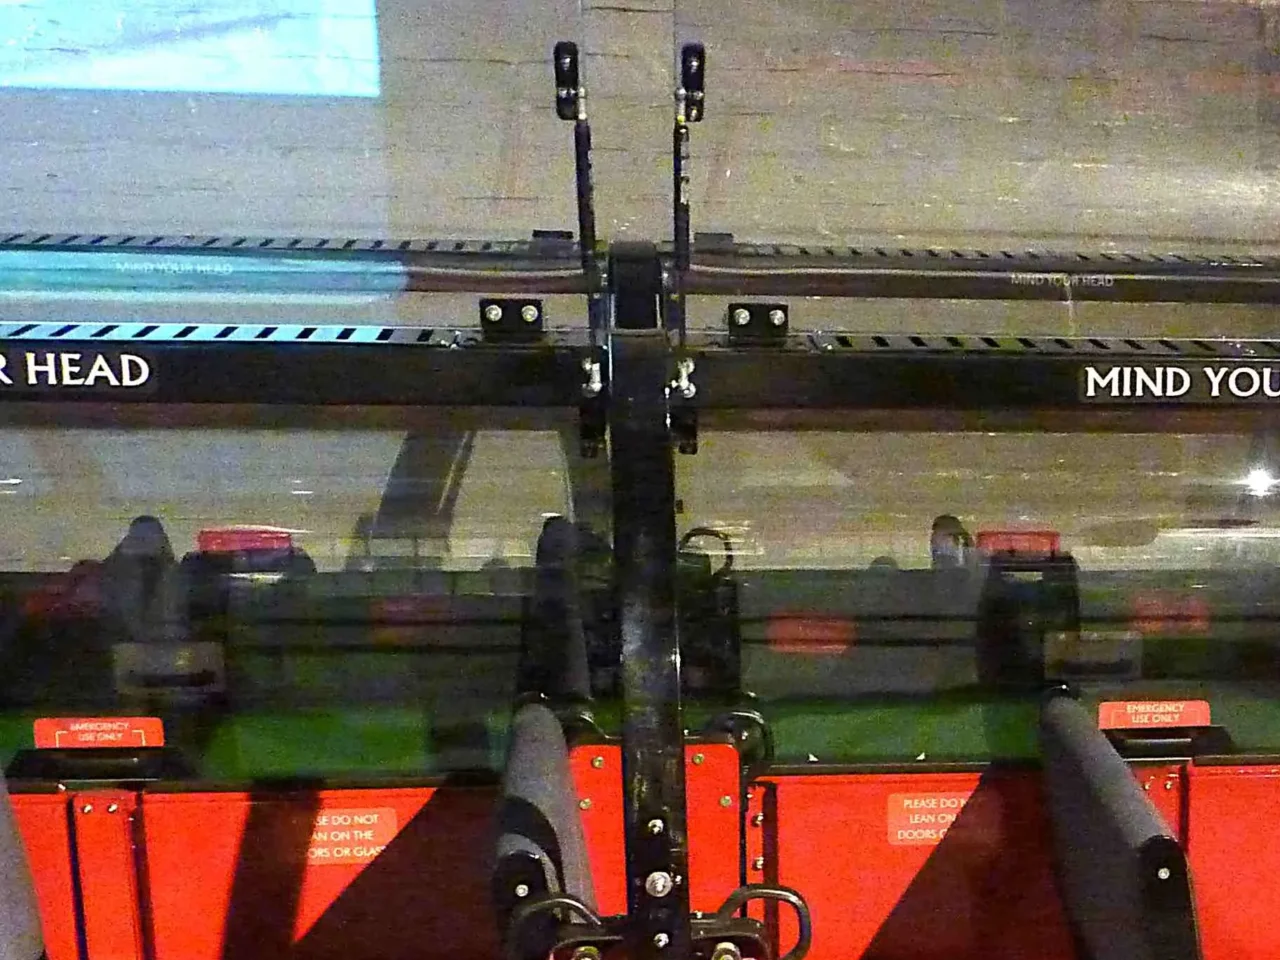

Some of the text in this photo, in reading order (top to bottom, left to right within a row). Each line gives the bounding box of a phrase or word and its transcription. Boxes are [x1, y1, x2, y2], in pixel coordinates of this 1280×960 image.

[26, 352, 150, 386] HEAD
[1085, 366, 1191, 397] MIND
[1126, 703, 1185, 714] EMERGENCY
[1131, 713, 1181, 724] USE ONLY
[903, 798, 938, 809] PLEASE
[940, 797, 959, 808] DO
[331, 815, 352, 826] DO
[353, 814, 379, 825] NOT
[910, 813, 935, 824] LEAN
[330, 830, 350, 841] ON
[352, 829, 375, 840] THE
[897, 829, 937, 840] DOORS
[333, 846, 351, 858] OR
